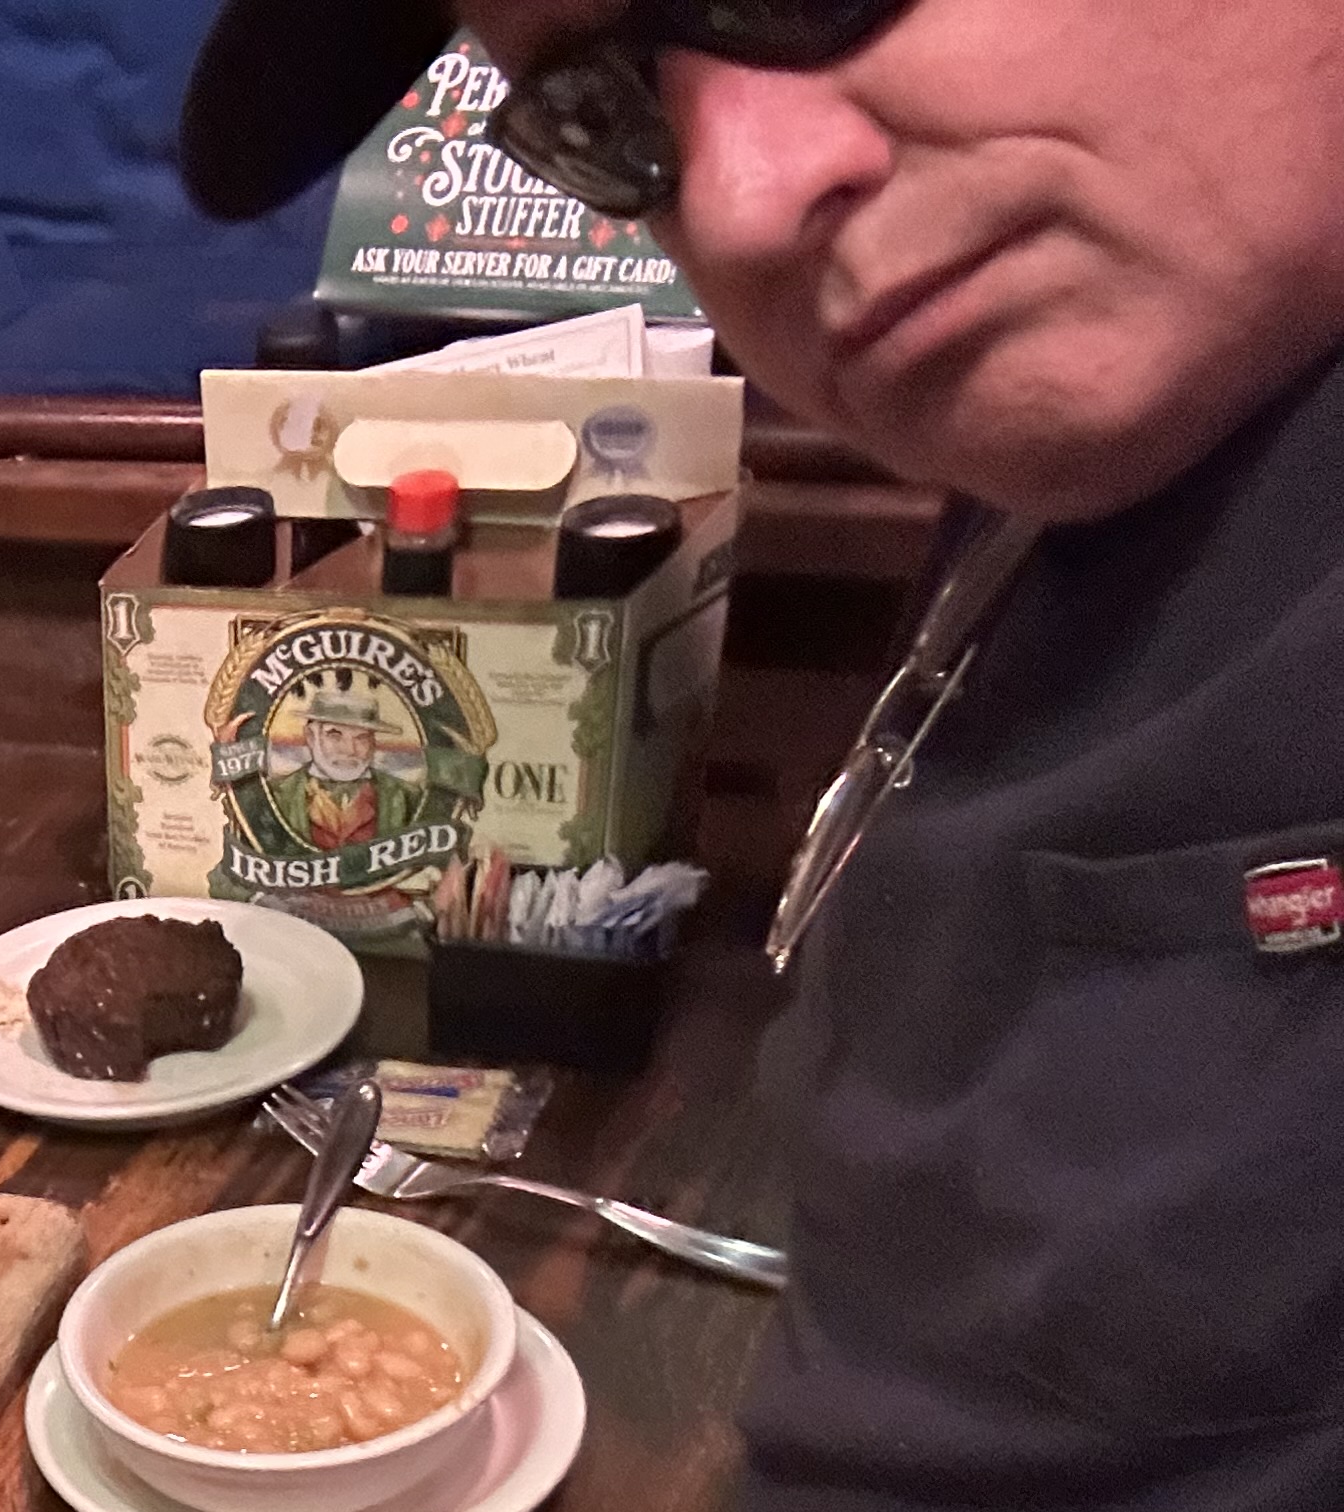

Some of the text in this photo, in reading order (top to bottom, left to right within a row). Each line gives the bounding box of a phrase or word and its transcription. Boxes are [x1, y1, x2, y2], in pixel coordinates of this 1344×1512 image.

[455, 195, 586, 239] STUFFER
[350, 247, 390, 273] ASK
[392, 248, 441, 274] YOUR
[441, 250, 512, 277] SERVER
[512, 253, 552, 279] FOR
[553, 255, 568, 280] A
[572, 255, 618, 282] GIFT
[618, 257, 677, 285] CARD!
[217, 750, 266, 777] 1977
[493, 760, 568, 804] ONE
[229, 823, 458, 889] IRISH RED
